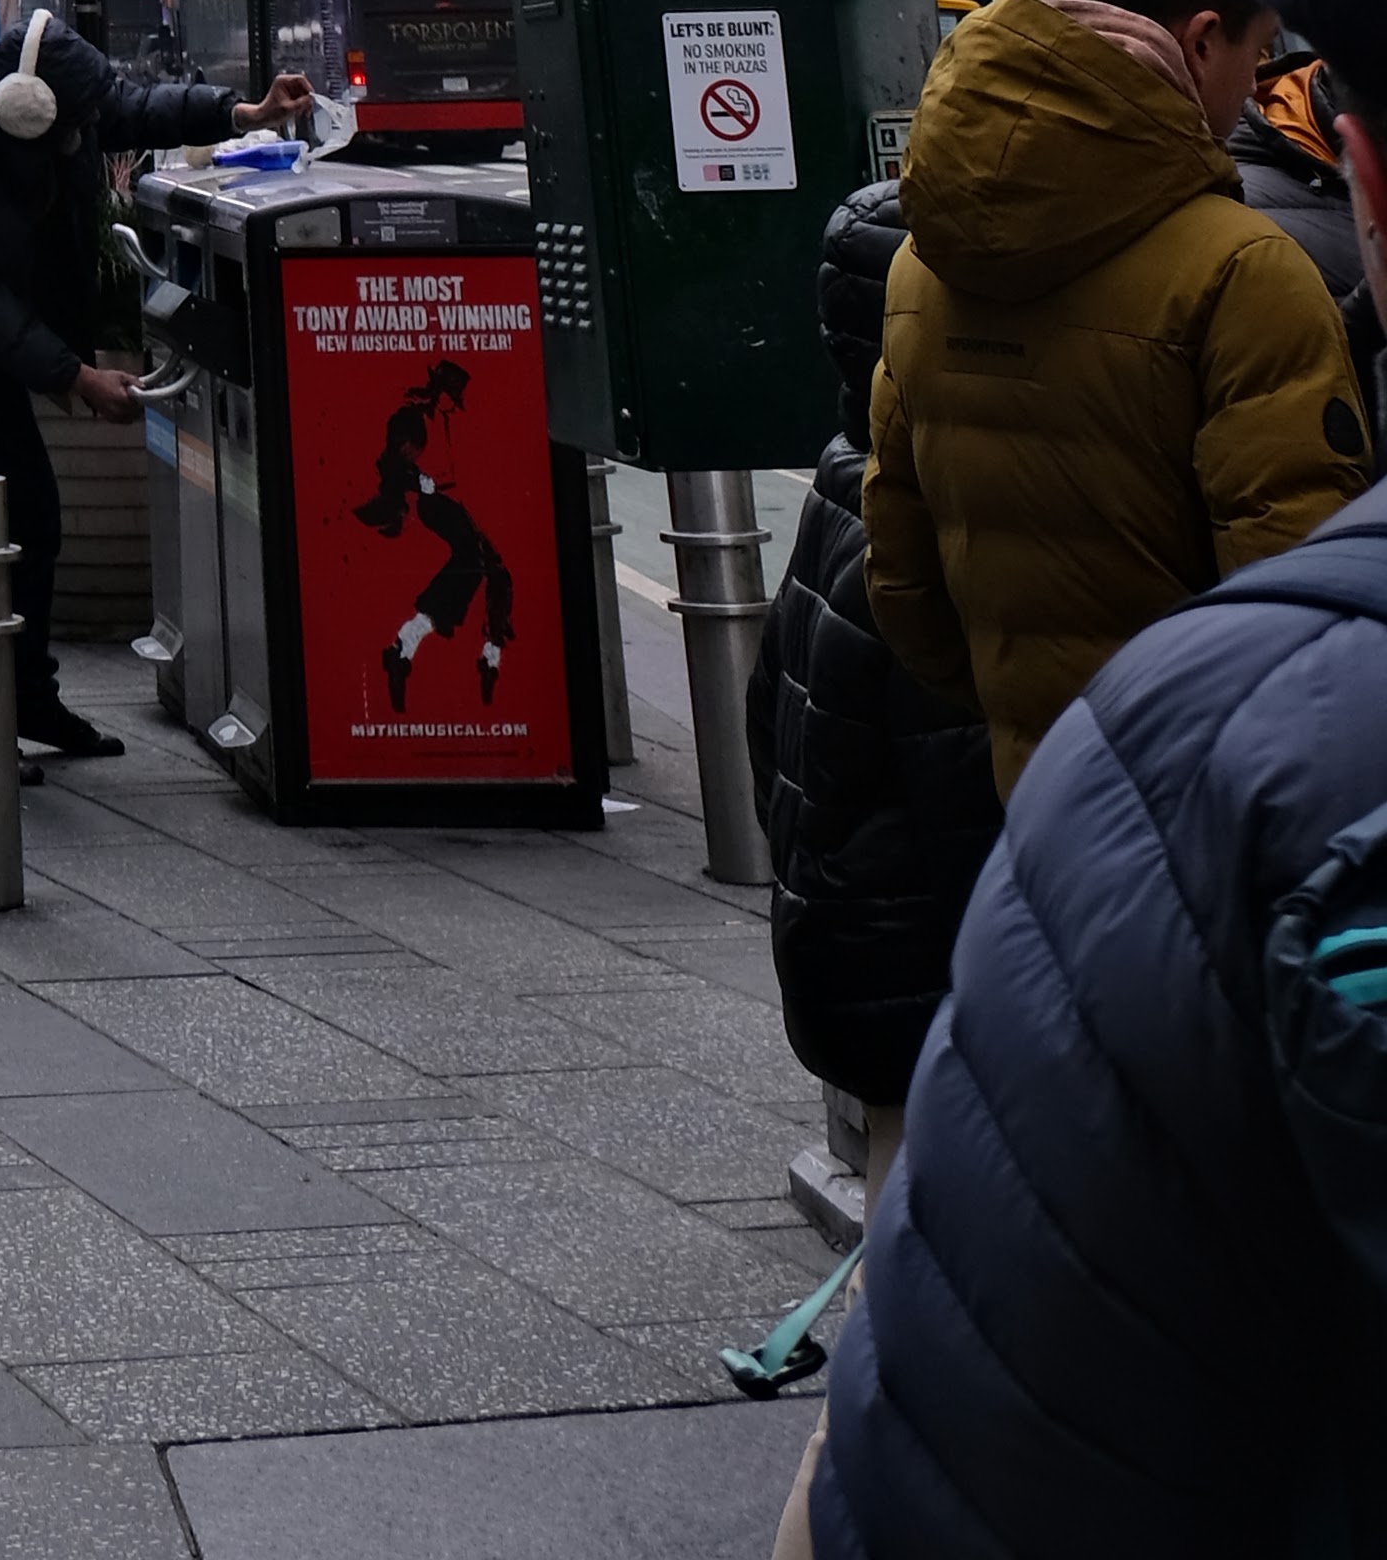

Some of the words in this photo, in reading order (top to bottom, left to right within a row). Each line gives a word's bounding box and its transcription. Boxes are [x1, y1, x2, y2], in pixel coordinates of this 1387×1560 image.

[670, 23, 704, 38] LET'S
[708, 23, 725, 37] BE
[728, 21, 775, 37] BLUNT:
[683, 44, 702, 58] NO
[704, 43, 766, 58] SMOKING
[684, 61, 696, 74] IN
[699, 61, 721, 74] THE
[724, 60, 768, 73] PLAZAS
[356, 276, 399, 302] THE
[403, 276, 464, 302] MOST
[293, 306, 349, 331] TONY
[354, 304, 531, 331] AWARD-WINNING
[316, 335, 347, 352] NEW
[352, 334, 416, 352] MUSICAL
[419, 334, 436, 351] OF
[440, 334, 467, 351] THE
[470, 334, 512, 351] YEAR!
